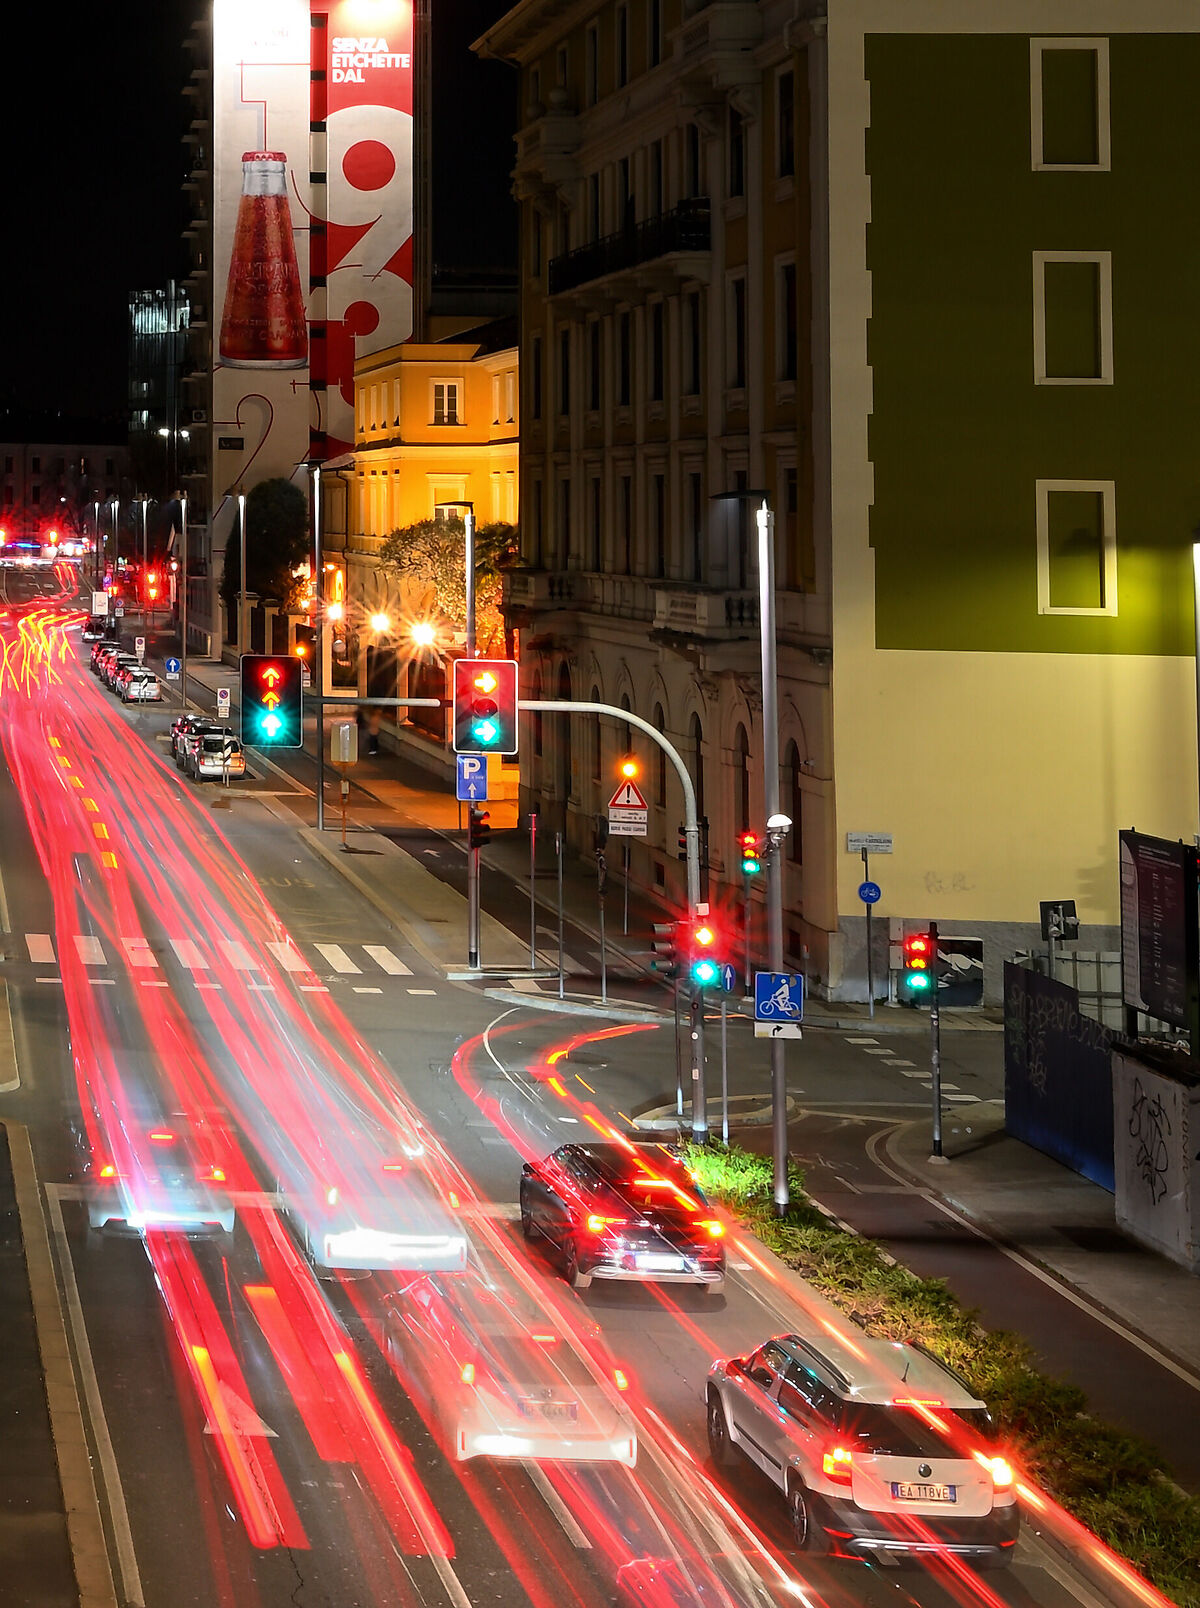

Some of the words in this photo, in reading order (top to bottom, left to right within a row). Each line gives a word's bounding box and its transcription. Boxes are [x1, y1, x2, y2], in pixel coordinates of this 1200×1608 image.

[332, 37, 389, 53] SENZA
[332, 53, 411, 68] ETICHETTE
[332, 69, 365, 83] DAL
[463, 757, 481, 780] P
[900, 1485, 913, 1497] EA
[917, 1486, 949, 1499] 118VE
